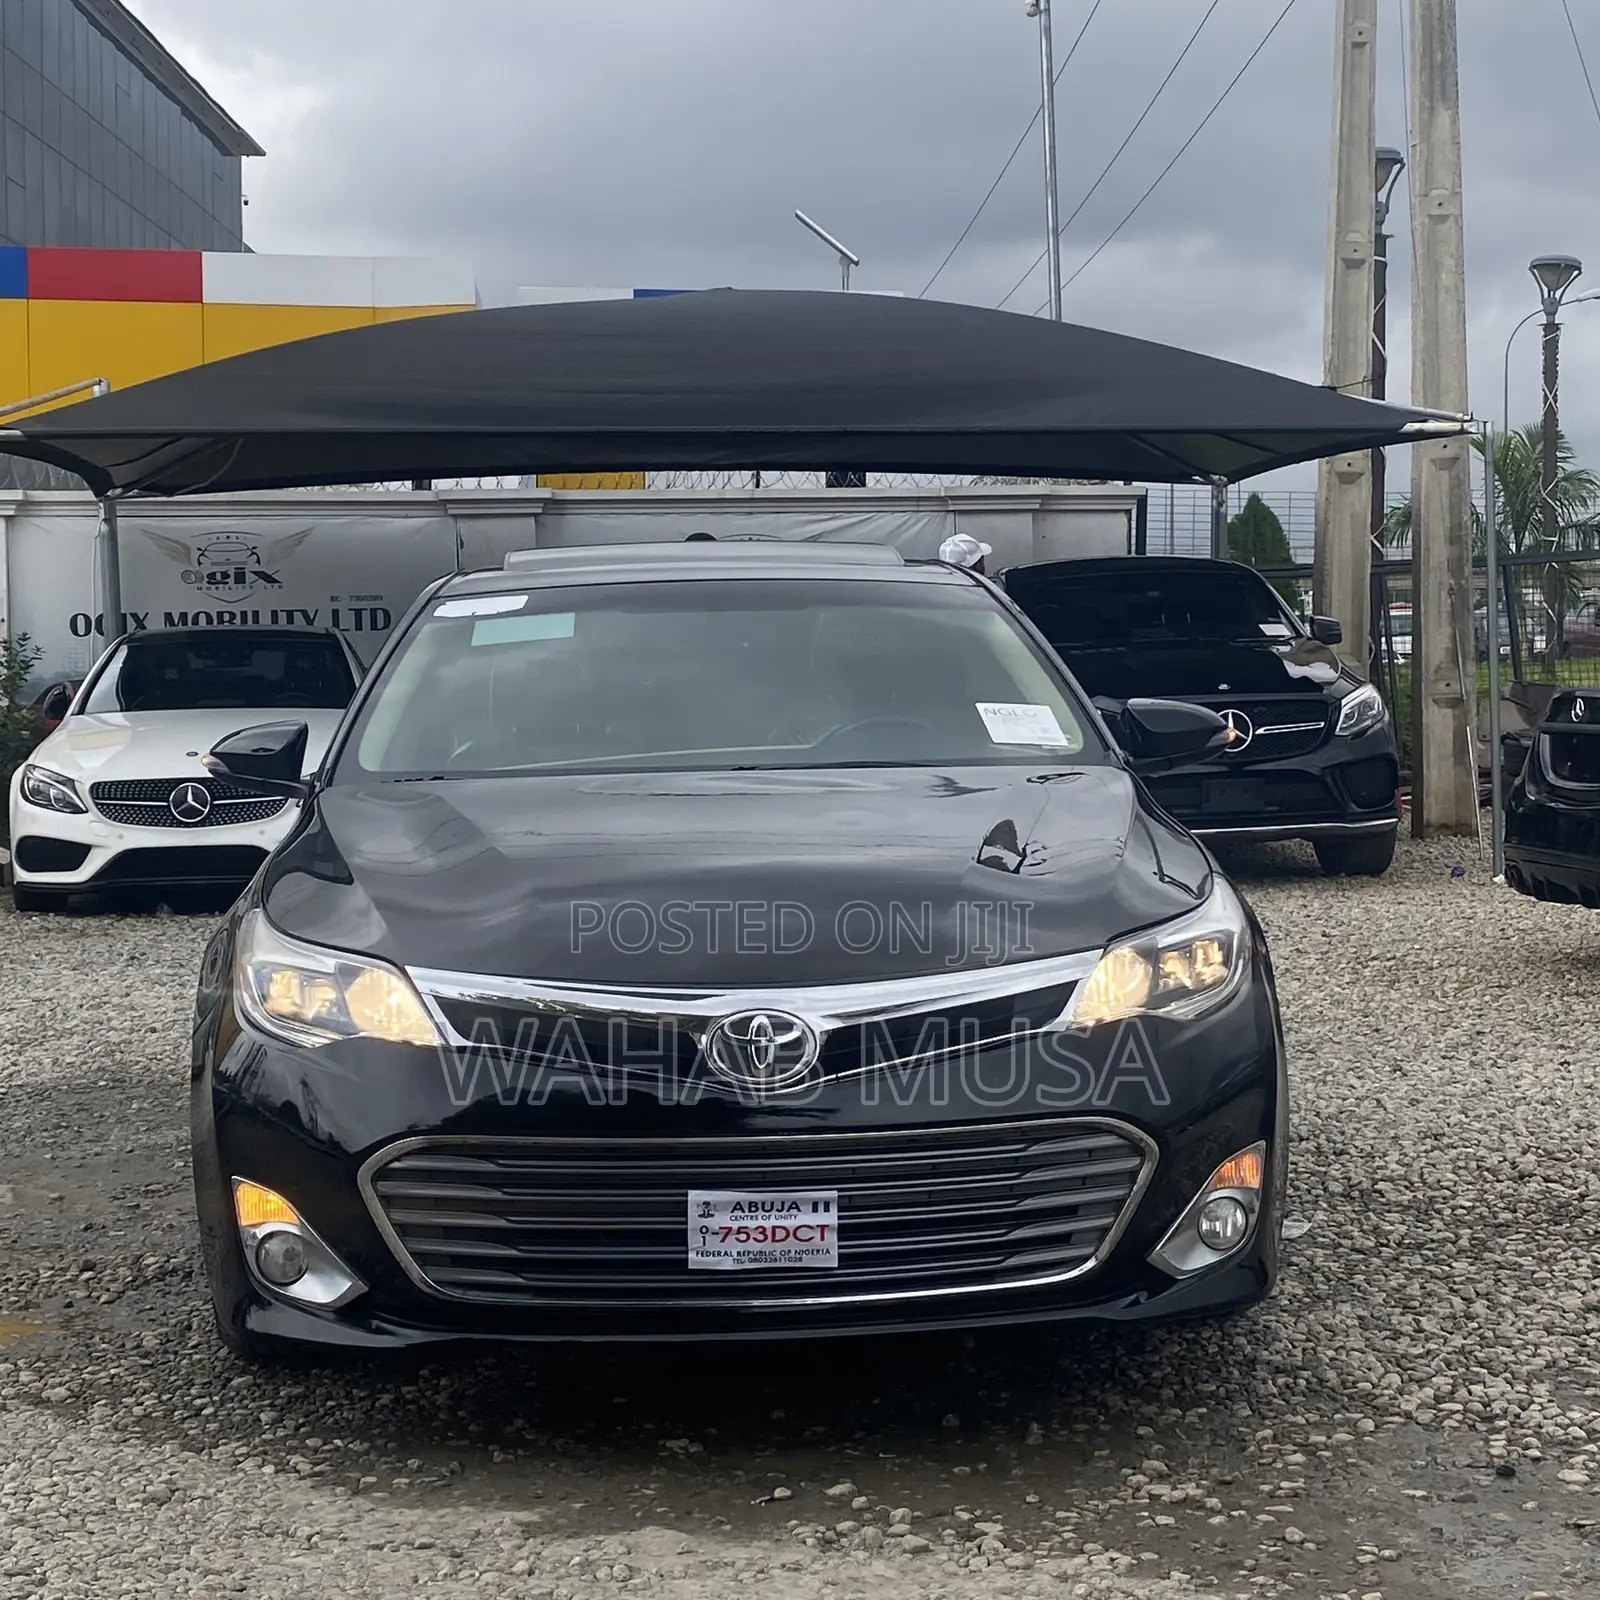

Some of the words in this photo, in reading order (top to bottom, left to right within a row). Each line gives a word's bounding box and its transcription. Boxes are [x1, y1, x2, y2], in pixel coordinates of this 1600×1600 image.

[331, 607, 392, 631] LTD
[730, 1200, 802, 1214] ABUJA
[729, 1214, 759, 1222] CENTRE
[774, 1213, 799, 1221] UNITY
[737, 1249, 777, 1257] REPUBLIC
[794, 1248, 831, 1256] NIGERIA
